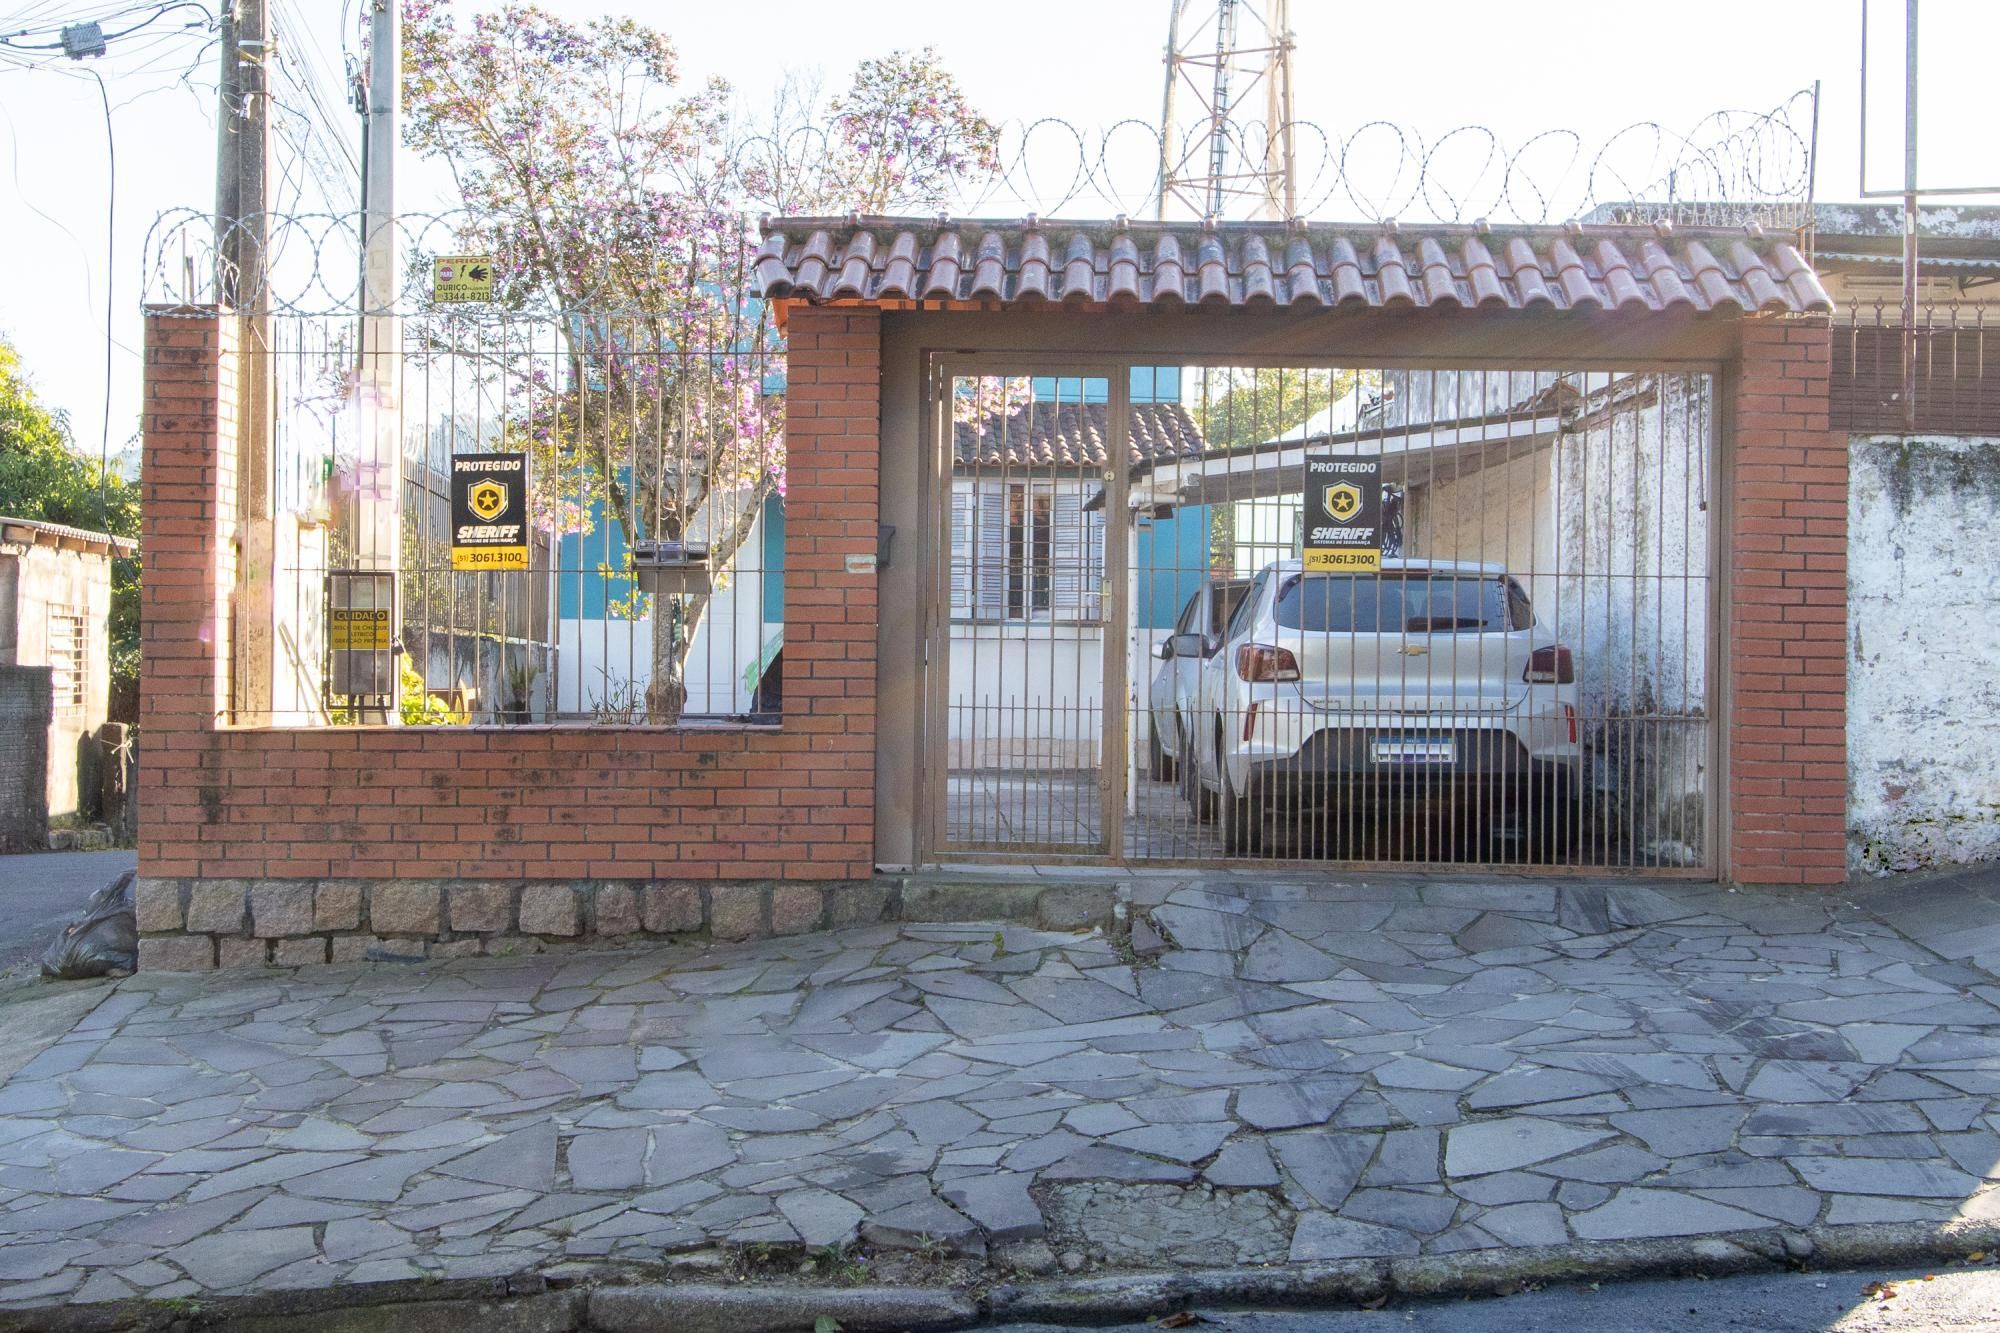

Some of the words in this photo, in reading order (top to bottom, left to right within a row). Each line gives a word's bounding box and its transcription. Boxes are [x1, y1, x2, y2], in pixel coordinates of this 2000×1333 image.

[437, 284, 467, 292] OURIÇO
[443, 292, 489, 301] 3344-8213
[454, 460, 521, 472] PROTEGIDO
[1310, 462, 1377, 473] PROTEGIDO
[457, 525, 520, 539] SHERIFF
[1310, 527, 1374, 540] SHERIFF
[469, 552, 522, 562] 3061.3100
[1321, 554, 1375, 564] 3061.3100
